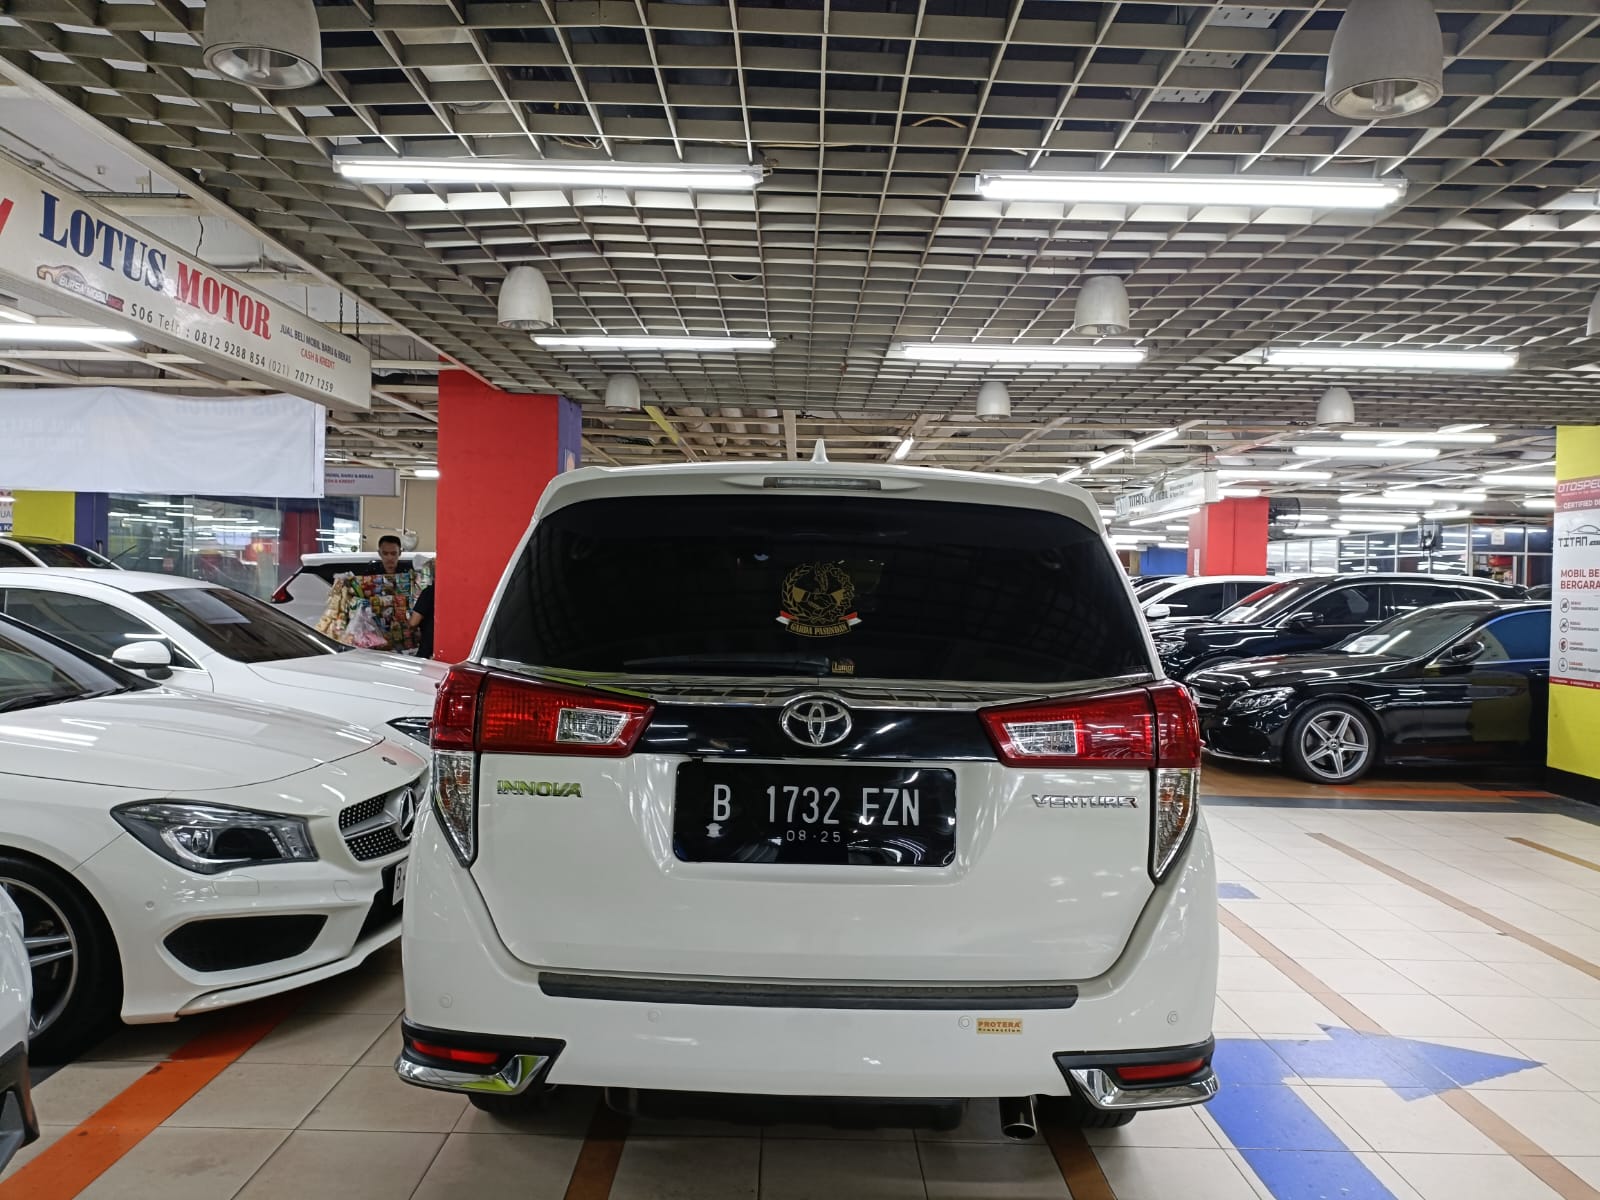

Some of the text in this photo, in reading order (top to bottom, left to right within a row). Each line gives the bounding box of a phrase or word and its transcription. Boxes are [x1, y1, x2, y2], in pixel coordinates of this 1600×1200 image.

[39, 190, 271, 340] LOTUS MOTOR
[280, 324, 294, 338] JUAL
[294, 330, 306, 343] BELI
[131, 303, 153, 323] S06
[194, 330, 221, 349] 0812
[224, 341, 246, 359] 9288
[249, 352, 265, 367] 854
[268, 359, 290, 377] (021)
[295, 369, 314, 385] 7077
[317, 378, 334, 393] 1259
[300, 348, 315, 361] CASH
[1558, 536, 1588, 547] TITAN
[1560, 569, 1587, 578] MOBIL
[497, 780, 582, 798] INNOVA
[713, 784, 732, 821] B
[767, 786, 840, 825] 1732
[1032, 794, 1139, 809] VENTURER
